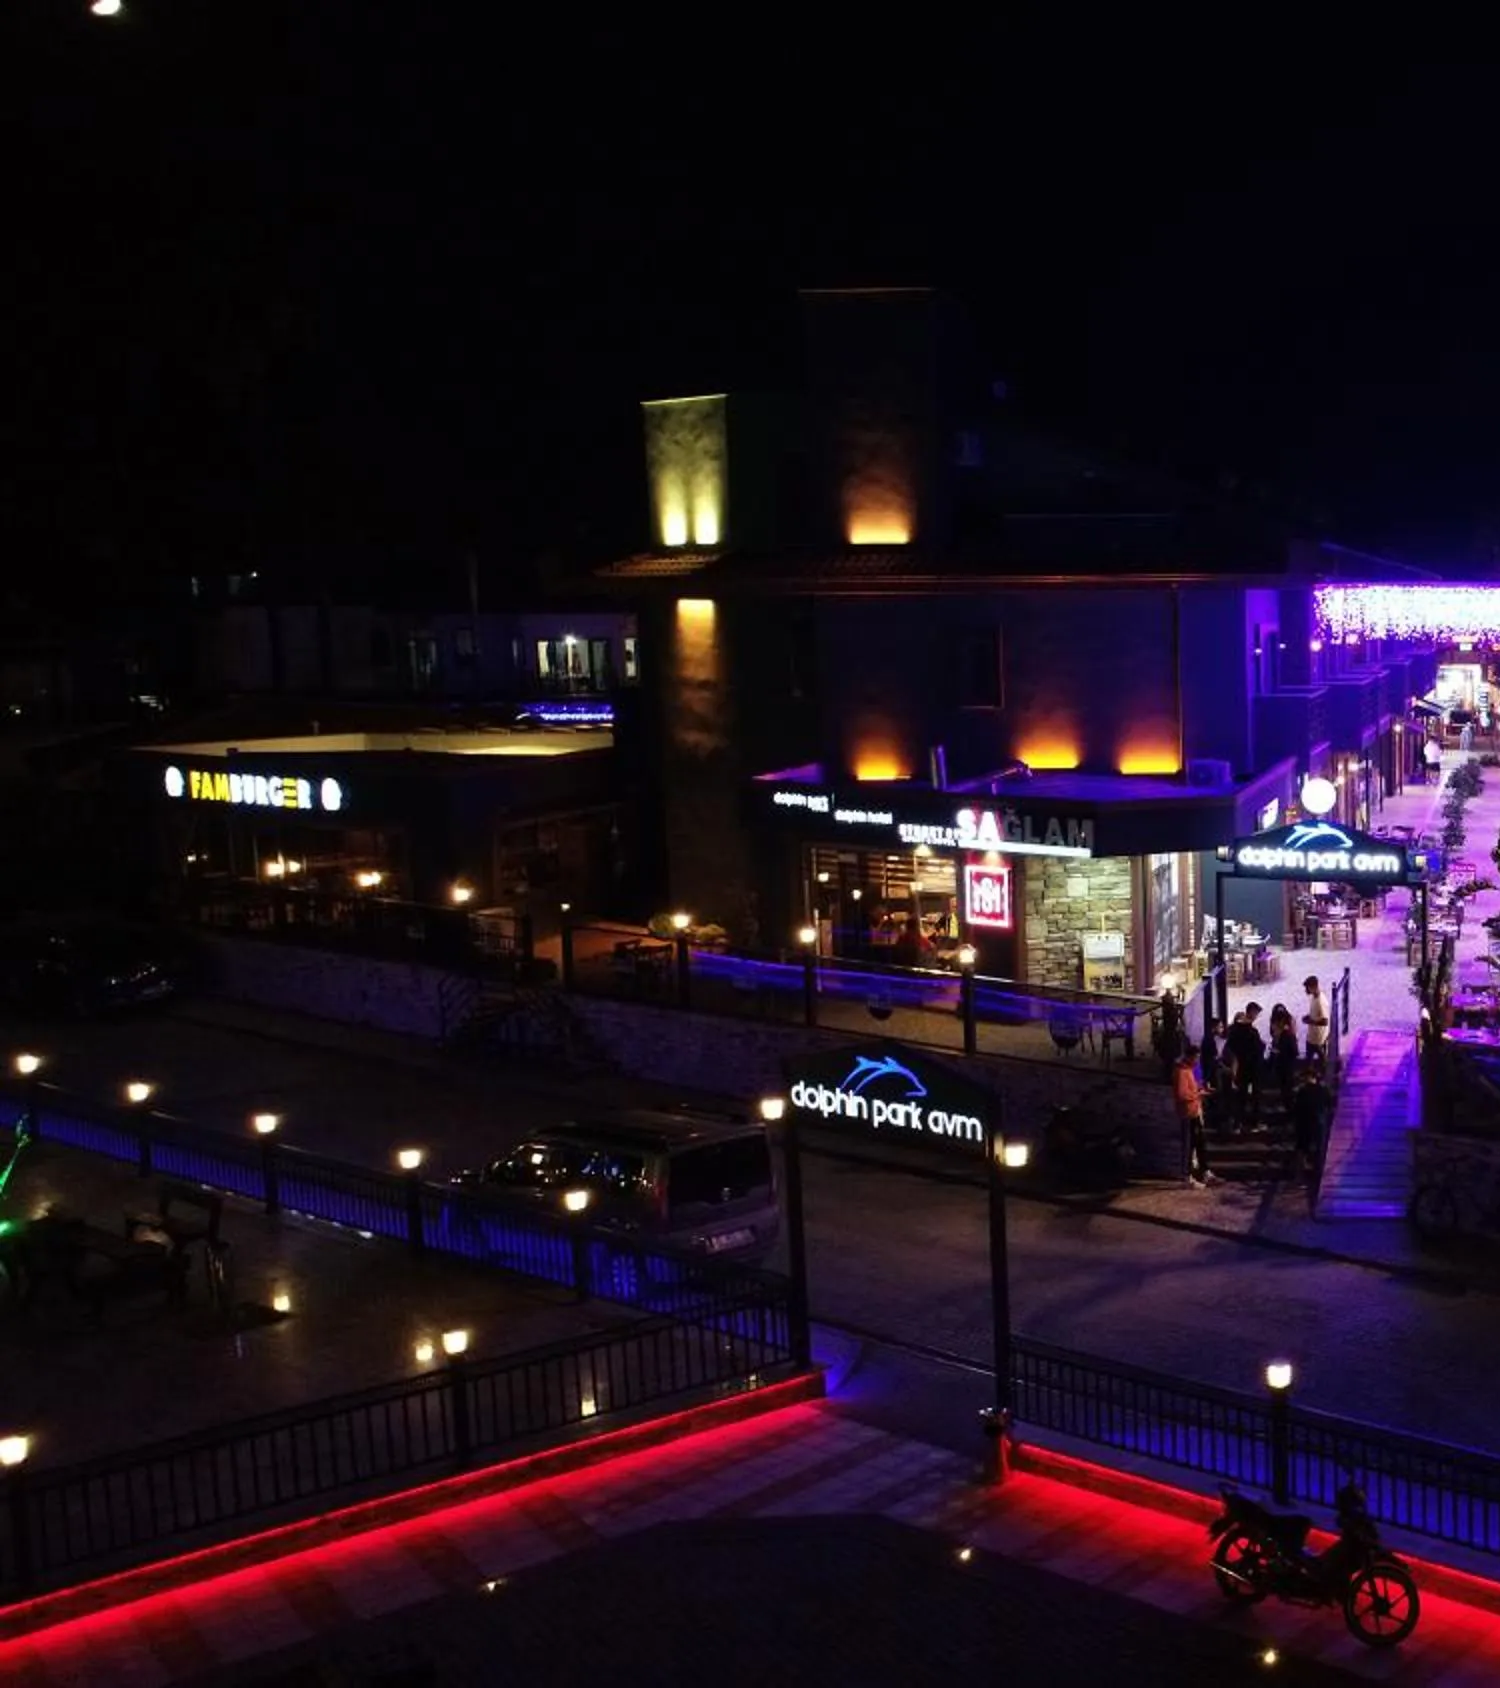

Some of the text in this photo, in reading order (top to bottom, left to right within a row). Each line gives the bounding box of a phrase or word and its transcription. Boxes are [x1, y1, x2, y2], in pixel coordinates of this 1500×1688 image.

[190, 770, 312, 809] FAMBURGER
[1238, 846, 1400, 873] dolphin park avm
[791, 1080, 983, 1142] dolphin park avm
